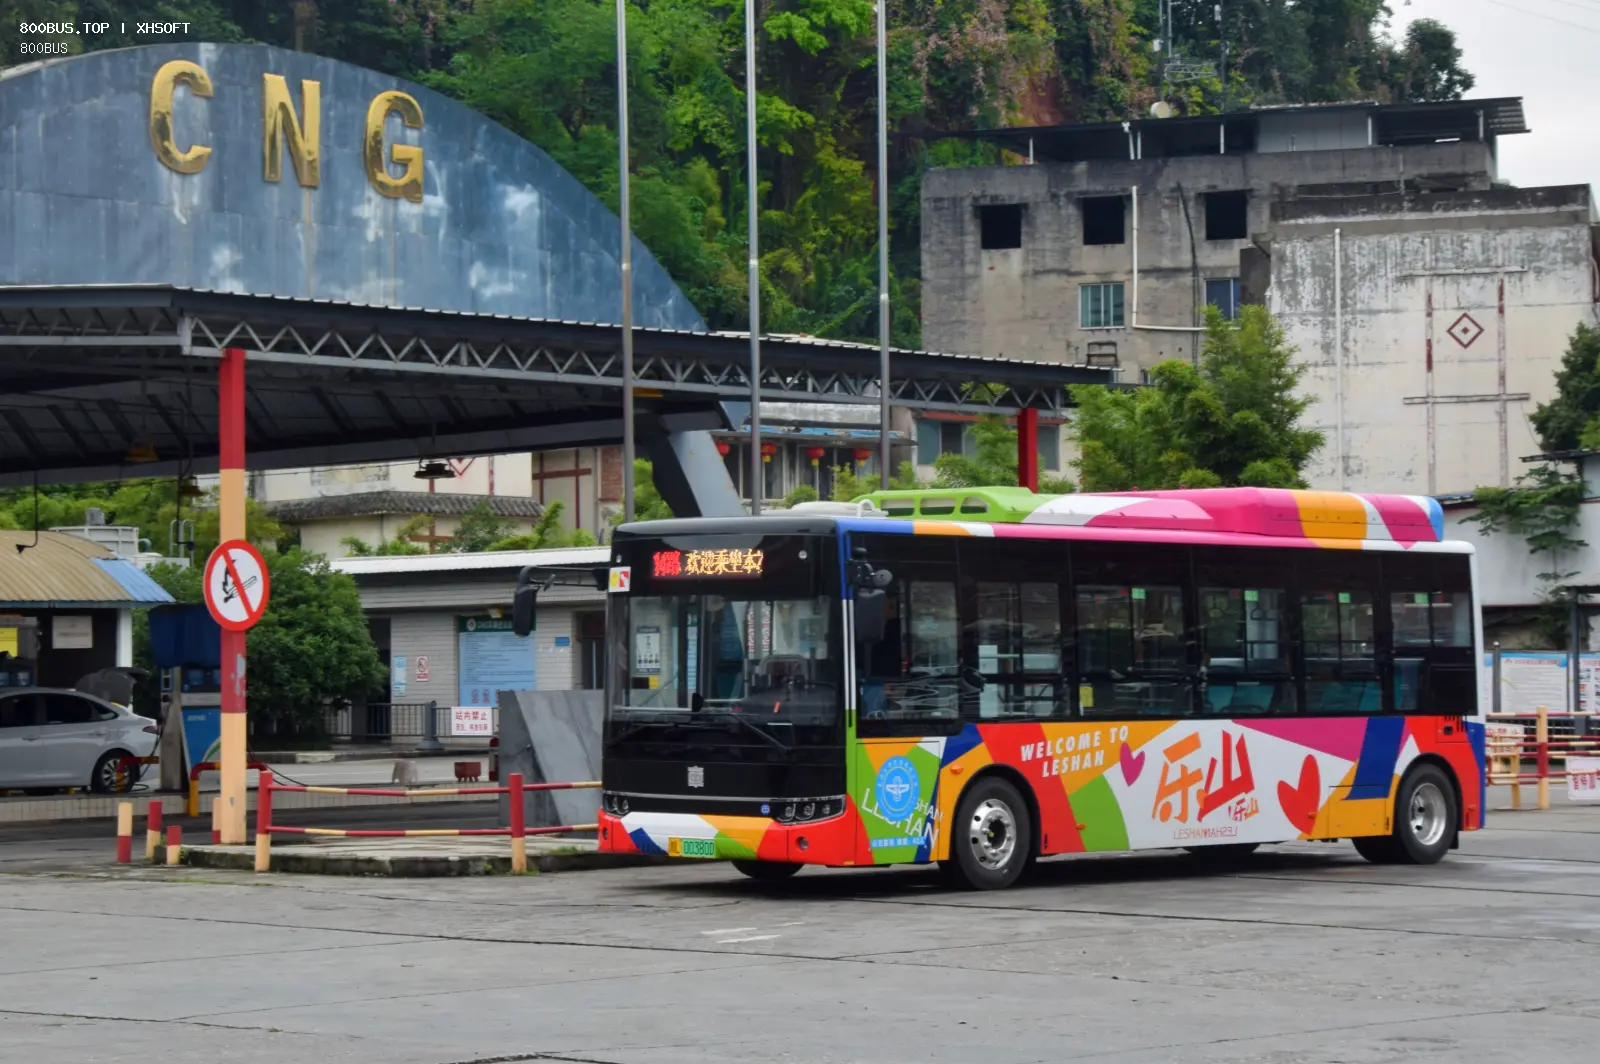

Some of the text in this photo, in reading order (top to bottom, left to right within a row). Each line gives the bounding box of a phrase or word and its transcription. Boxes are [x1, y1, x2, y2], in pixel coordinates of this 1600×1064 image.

[150, 59, 425, 204] CNG
[1020, 725, 1129, 762] WELCOME TO
[1042, 749, 1104, 778] LESHAN
[1152, 729, 1255, 825] 乐山
